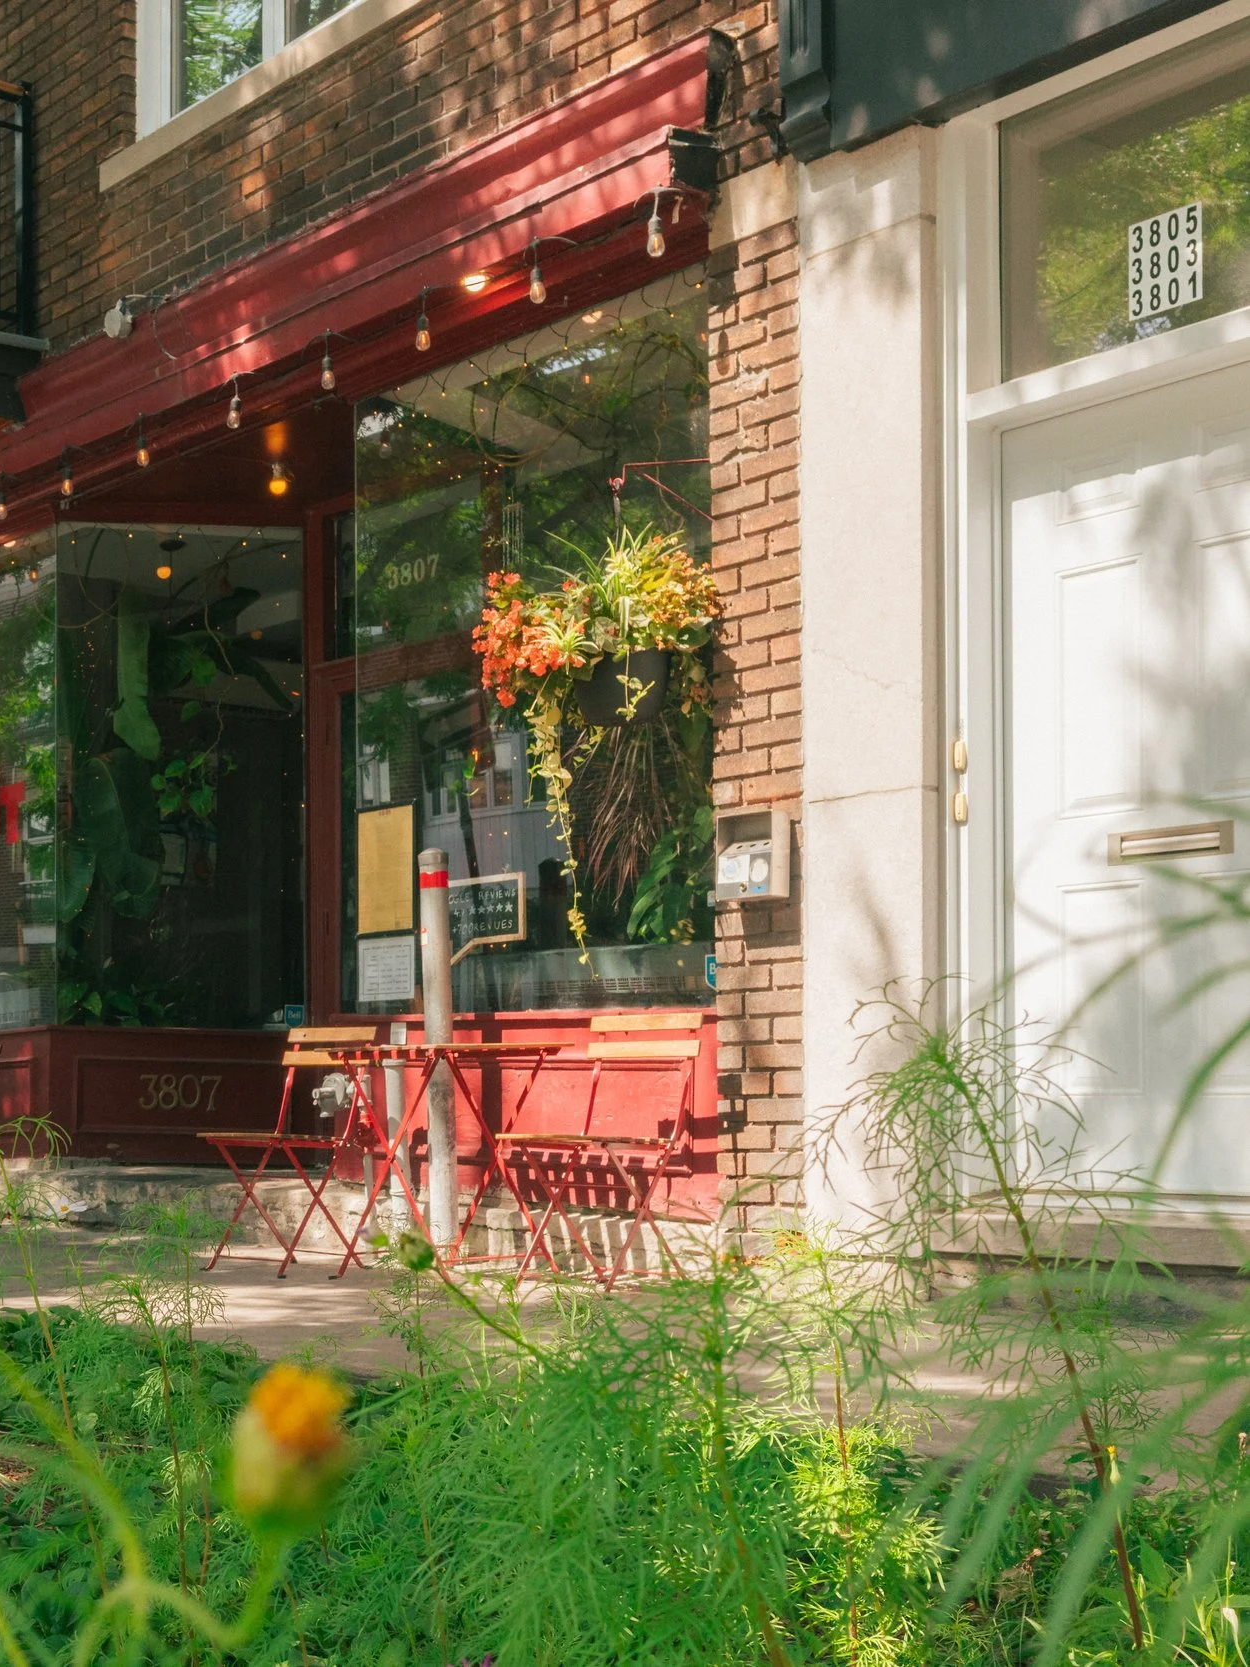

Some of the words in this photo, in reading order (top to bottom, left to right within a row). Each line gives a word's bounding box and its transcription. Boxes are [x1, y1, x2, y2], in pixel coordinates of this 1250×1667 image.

[1132, 205, 1198, 253] 3805
[1132, 239, 1198, 285] 3803
[1132, 271, 1197, 316] 3801
[388, 553, 440, 590] 3807
[139, 1073, 222, 1112] 3807
